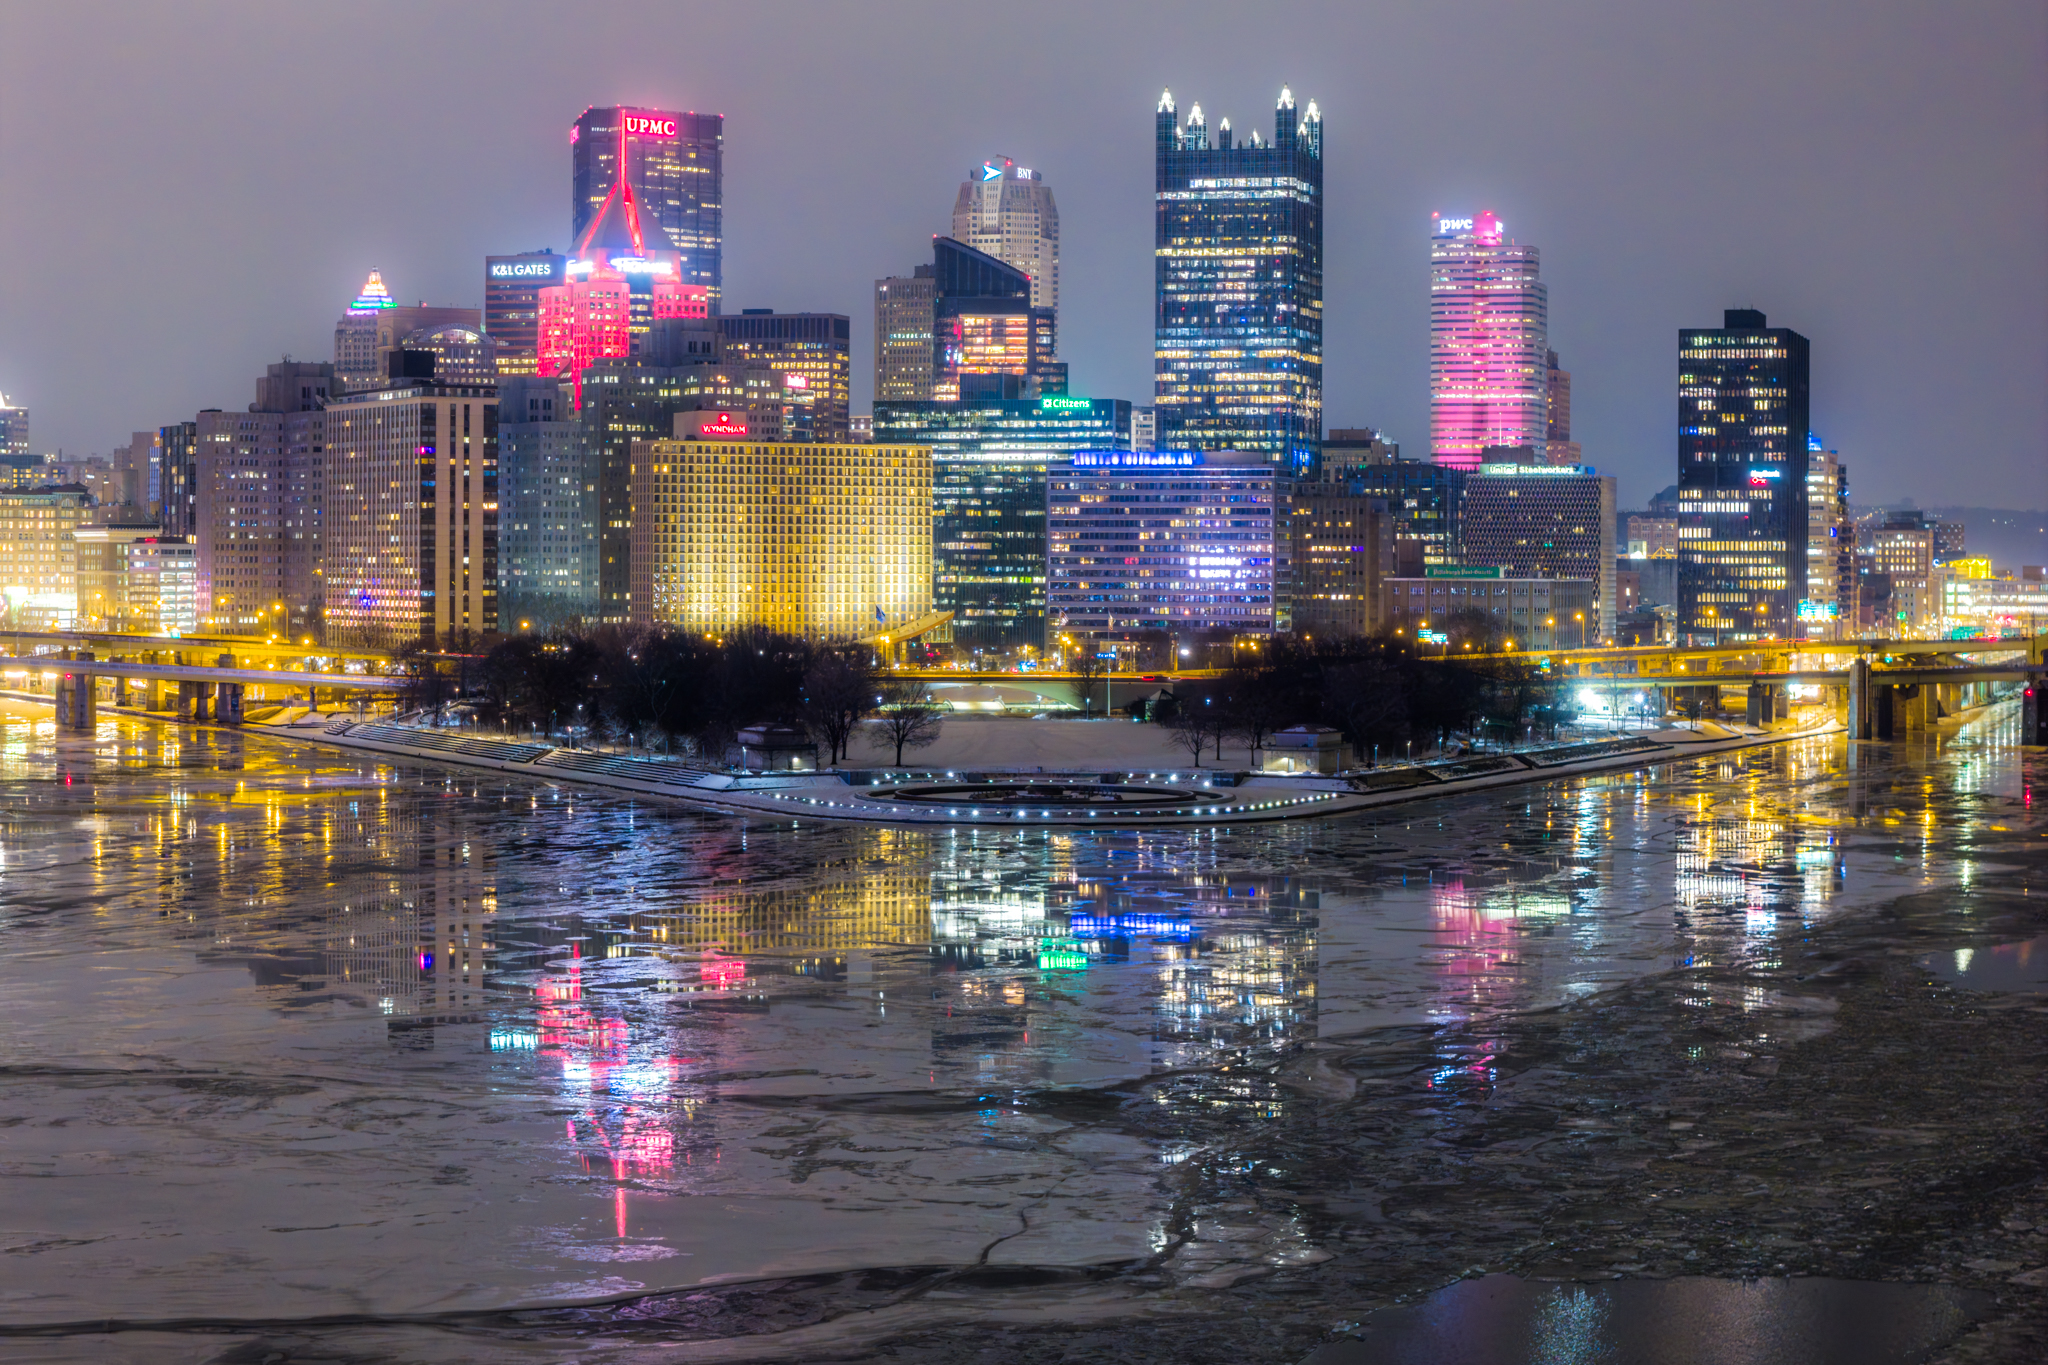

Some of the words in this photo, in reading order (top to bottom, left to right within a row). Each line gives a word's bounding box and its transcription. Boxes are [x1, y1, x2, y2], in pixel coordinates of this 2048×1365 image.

[626, 117, 675, 135] UPMC
[1017, 167, 1032, 179] BNY
[1440, 219, 1473, 233] pwc
[493, 265, 513, 275] K&L
[514, 264, 551, 275] GATES
[1053, 398, 1090, 408] Citizens
[703, 425, 746, 433] WYNDHAM
[1489, 466, 1517, 474] United
[1519, 466, 1574, 474] Steelworkers
